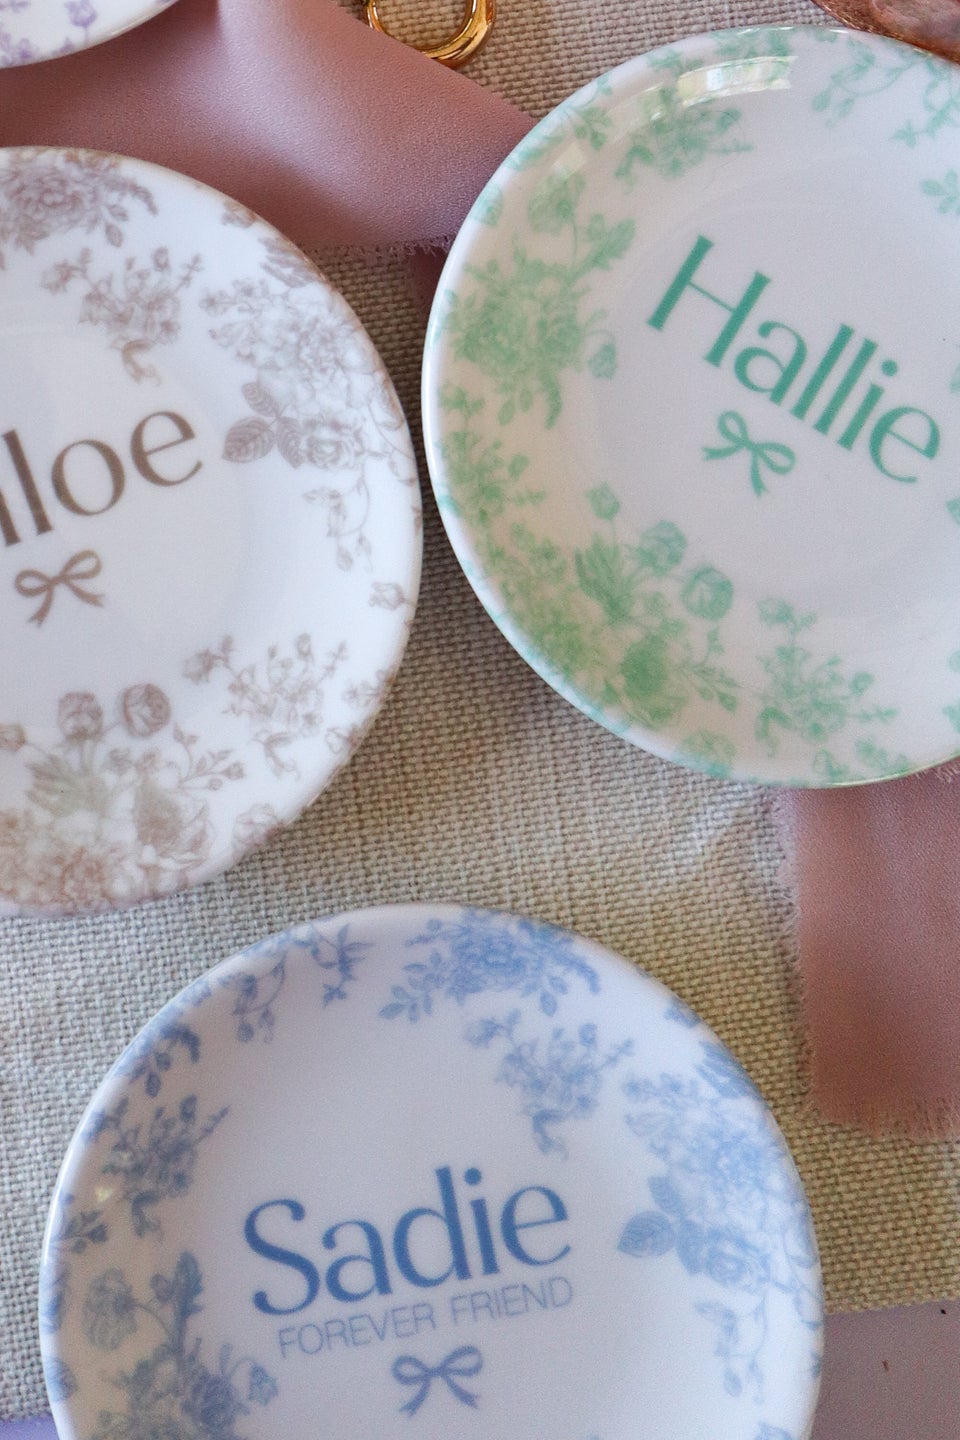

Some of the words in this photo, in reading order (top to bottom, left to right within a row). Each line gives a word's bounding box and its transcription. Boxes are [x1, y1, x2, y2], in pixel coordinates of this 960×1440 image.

[645, 234, 940, 484] Hallie
[243, 1165, 571, 1315] Sadie
[278, 1302, 437, 1359] FOREVER
[450, 1275, 573, 1327] FRIEND
